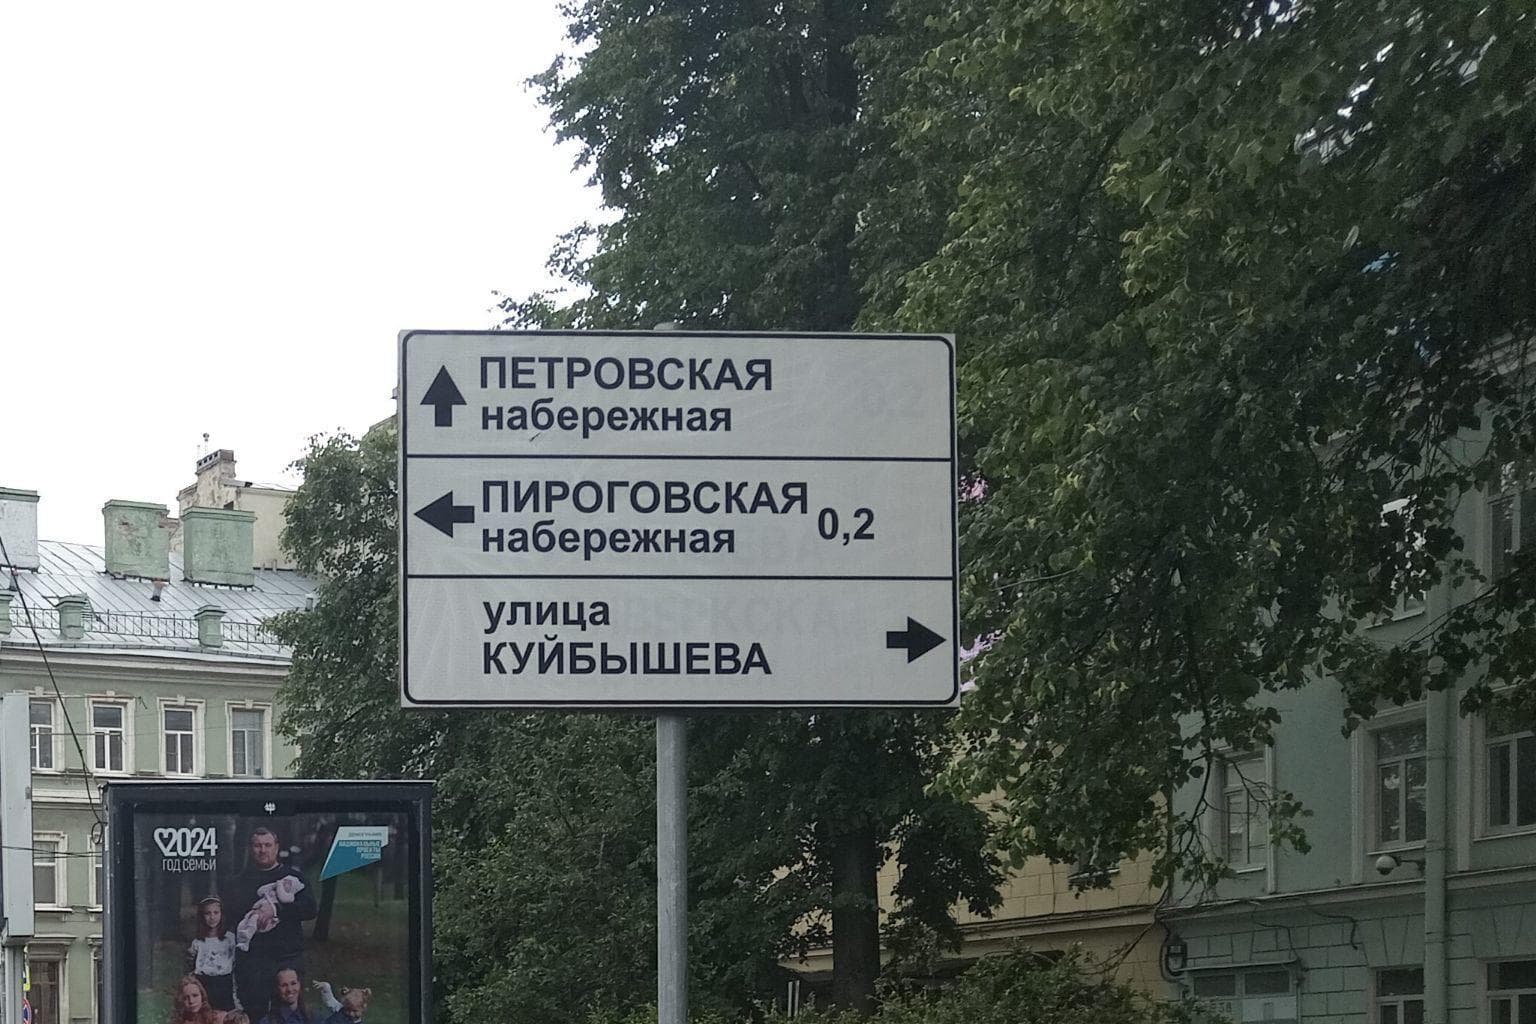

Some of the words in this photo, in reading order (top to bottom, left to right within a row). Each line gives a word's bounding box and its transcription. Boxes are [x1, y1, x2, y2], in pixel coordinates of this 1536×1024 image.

[479, 355, 773, 391] ПЕТРОВСКАЯ
[480, 396, 732, 438] набережная
[481, 480, 808, 514] ПИРОГОВСКАЯ
[481, 519, 736, 560] набережная
[817, 507, 875, 546] 0,2
[483, 599, 611, 633] улица
[482, 635, 773, 675] КУЙБЫШЕВА
[161, 827, 219, 857] 2024
